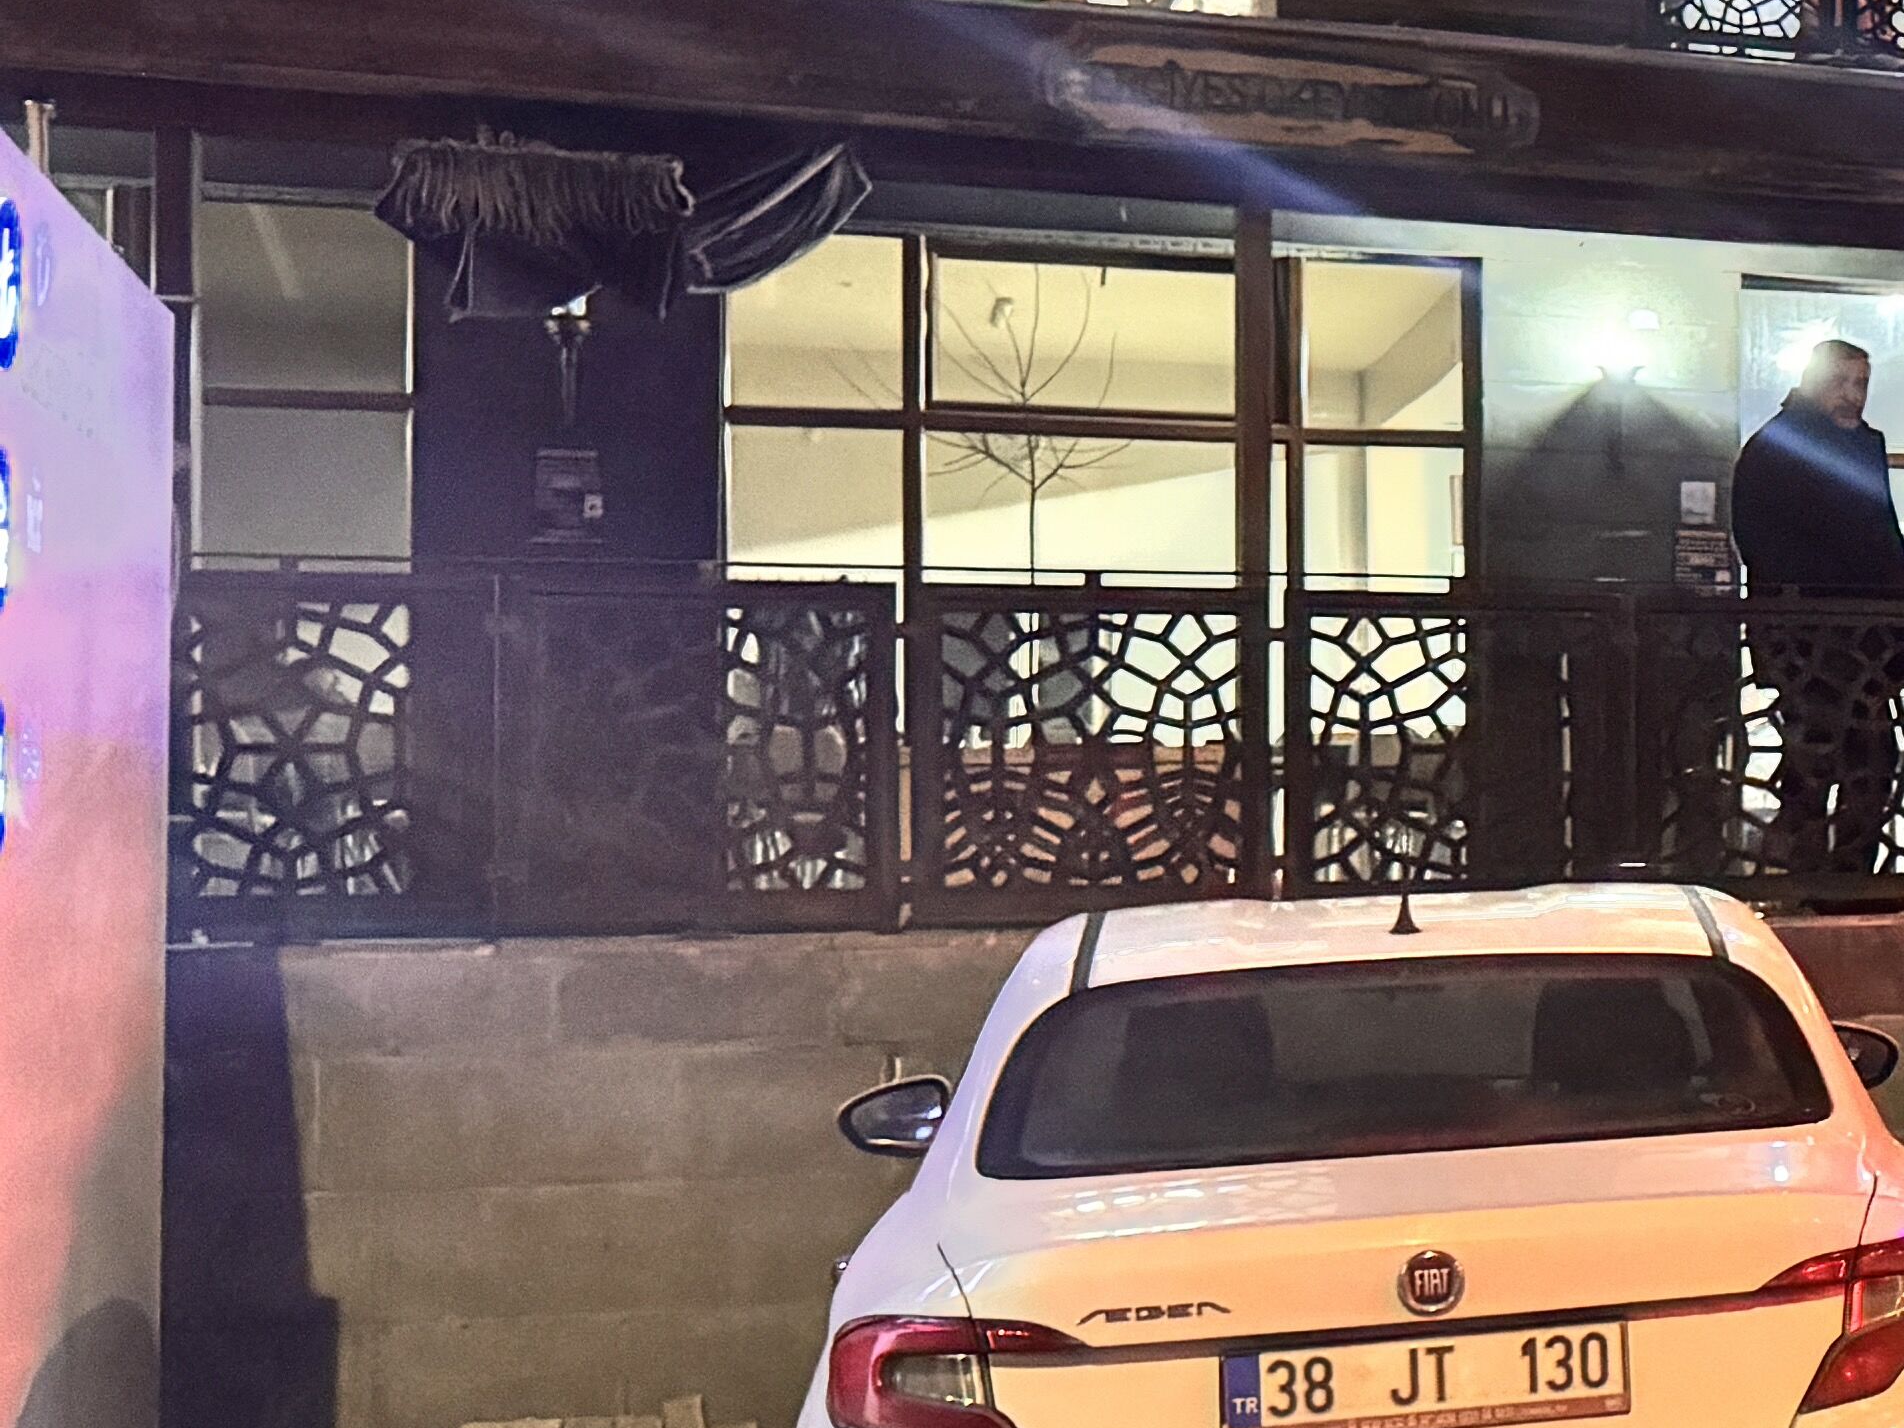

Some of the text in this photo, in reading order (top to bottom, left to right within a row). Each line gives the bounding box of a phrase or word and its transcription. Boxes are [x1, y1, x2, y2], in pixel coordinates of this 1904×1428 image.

[1414, 1268, 1450, 1298] FIAT
[1266, 1332, 1609, 1418] 38 JT 130
[1232, 1397, 1259, 1415] TR
